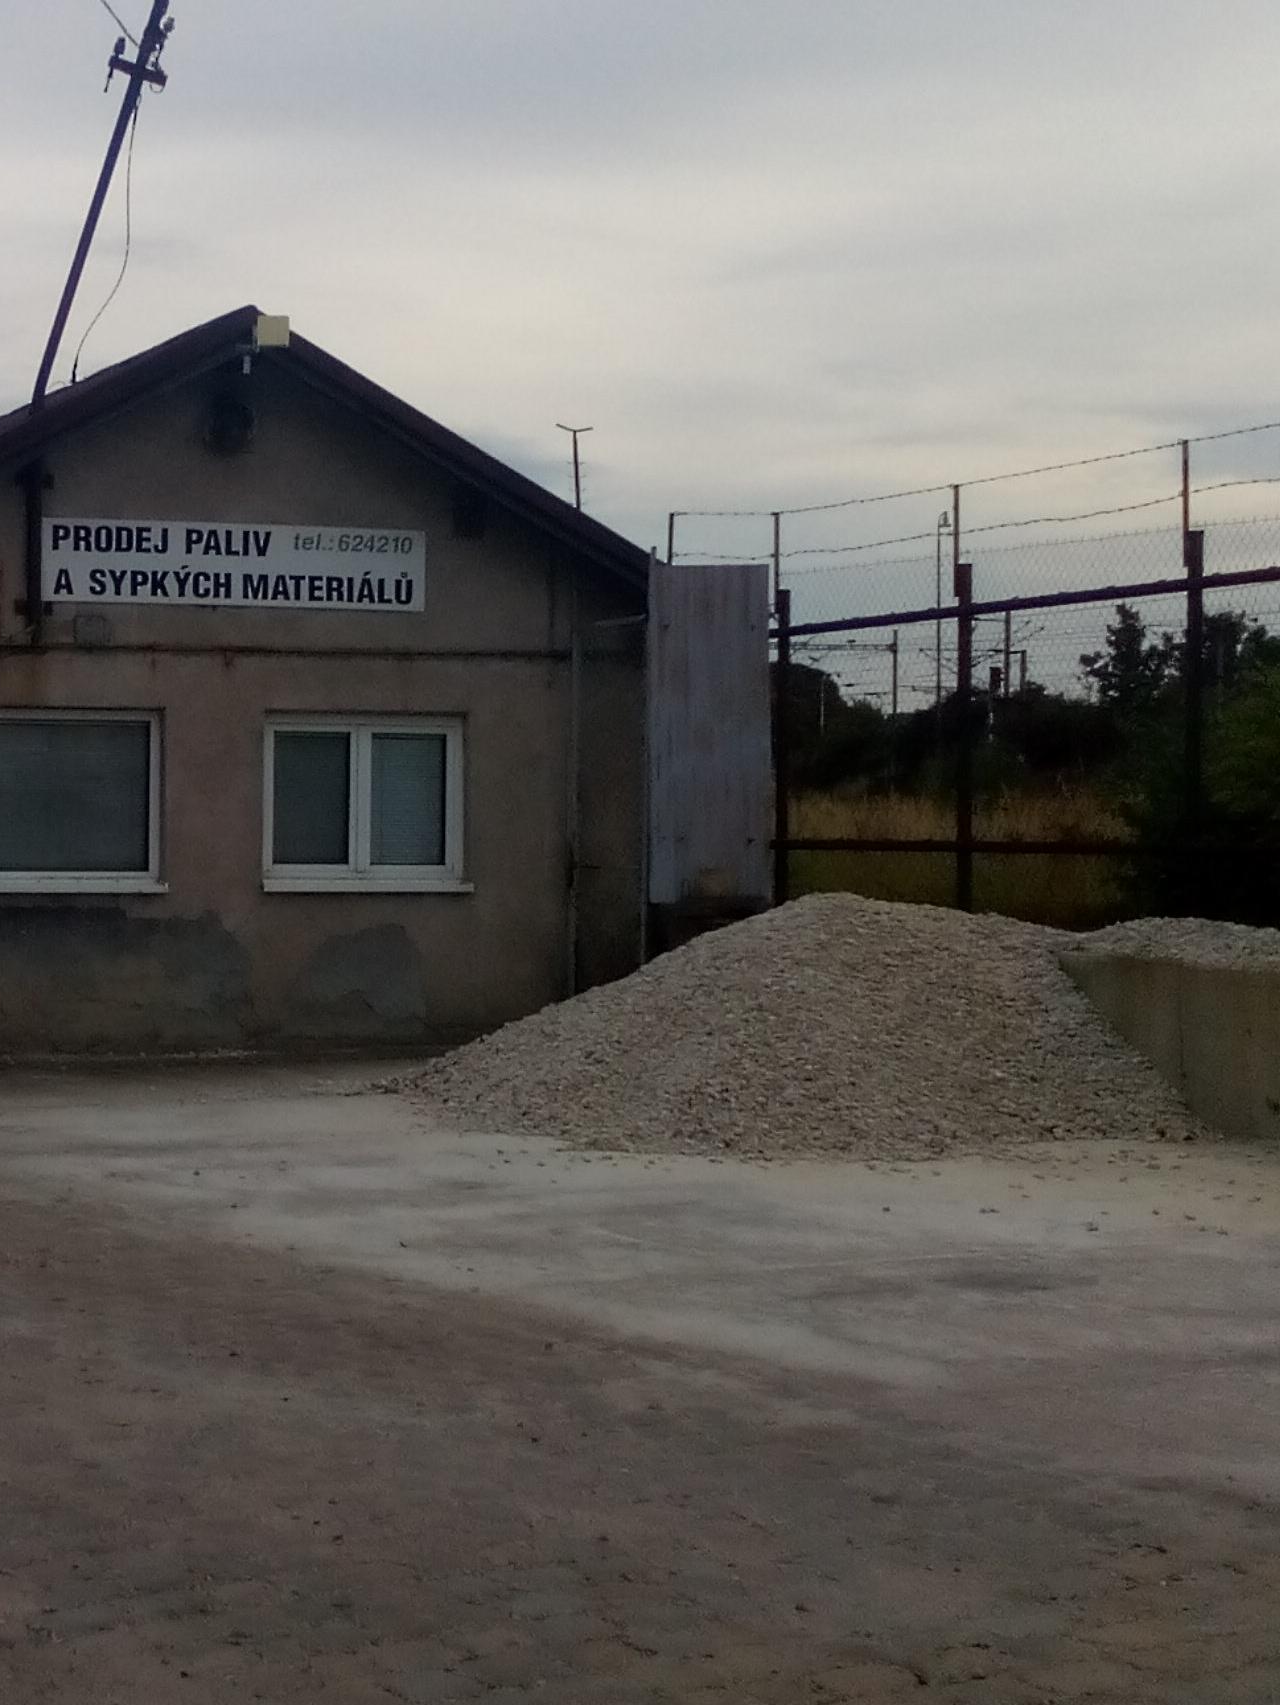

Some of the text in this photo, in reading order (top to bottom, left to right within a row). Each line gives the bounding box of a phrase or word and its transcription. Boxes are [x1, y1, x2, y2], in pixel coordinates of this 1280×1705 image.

[51, 524, 272, 557] PRODEJ PALIV
[53, 565, 414, 606] A SYPKÝCH MATERIÁLŮ
